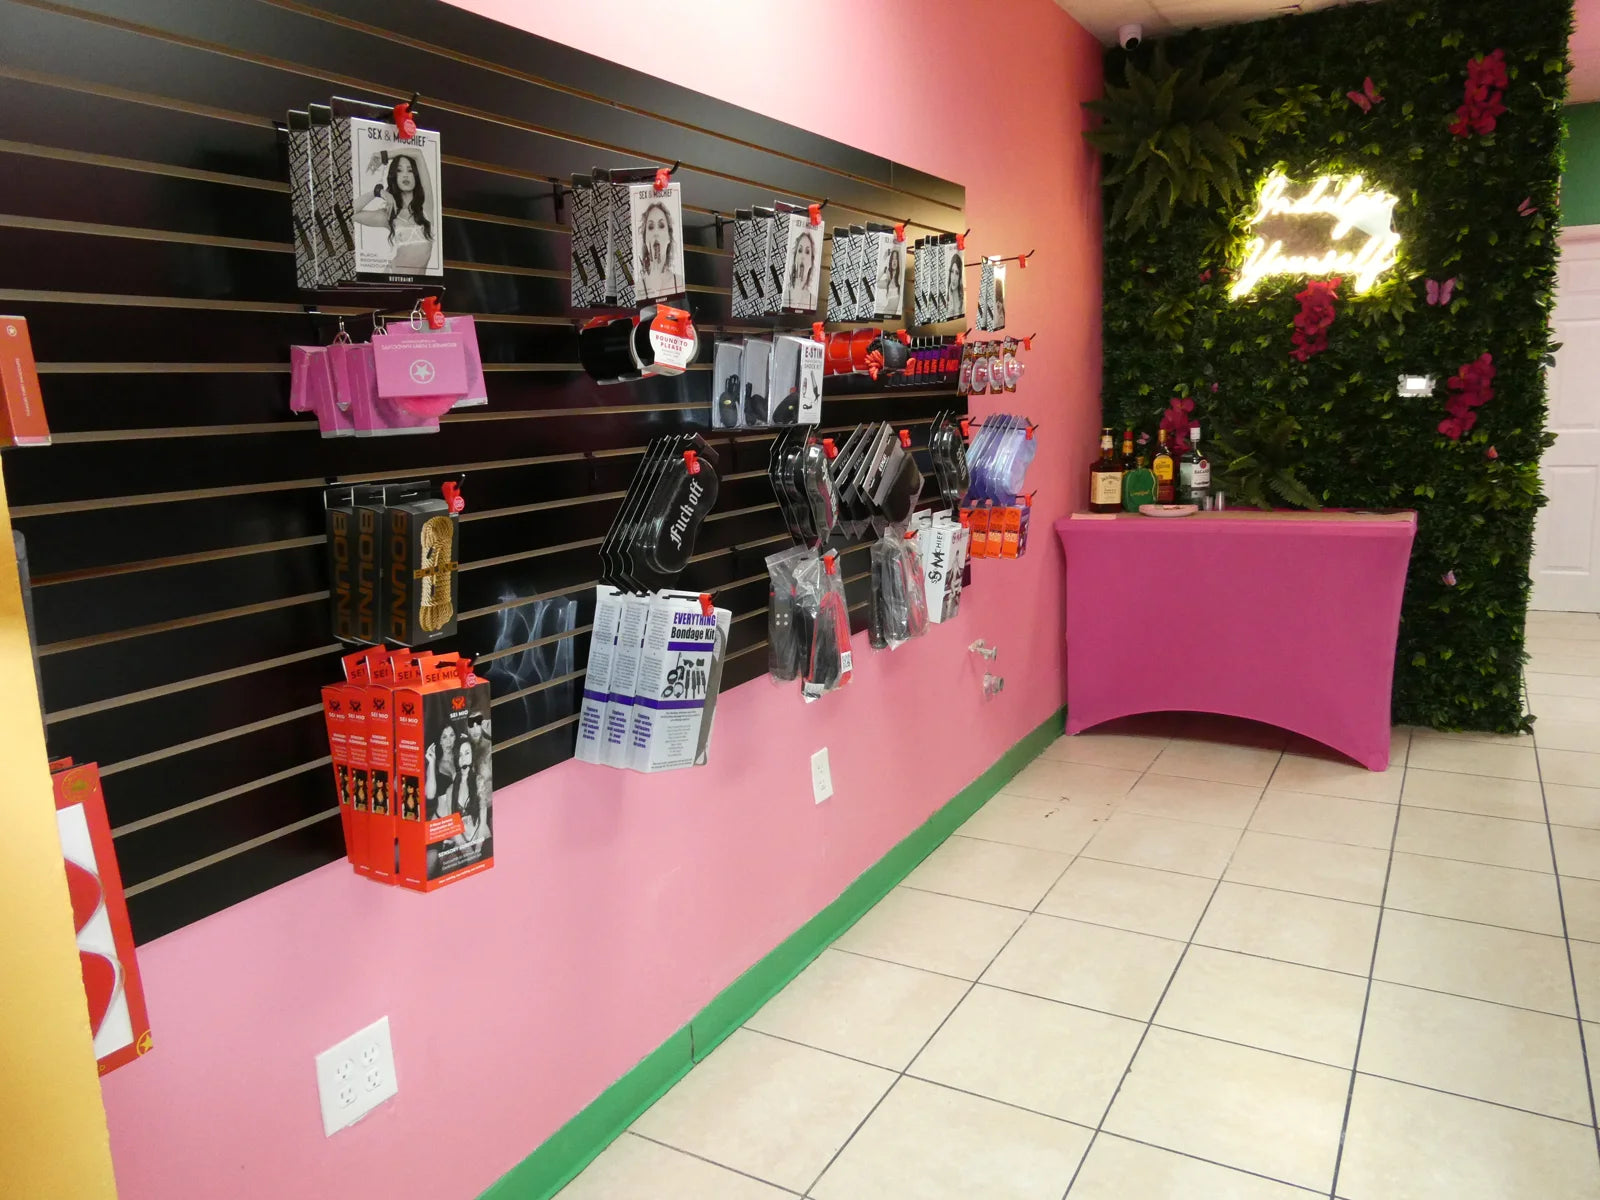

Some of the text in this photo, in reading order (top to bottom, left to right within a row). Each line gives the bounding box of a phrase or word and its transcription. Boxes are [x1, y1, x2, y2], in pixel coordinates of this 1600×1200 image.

[368, 127, 382, 140] SEX
[384, 130, 391, 141] &
[655, 334, 678, 345] BOUND
[660, 341, 682, 351] PLEASE
[669, 478, 704, 551] Fuck off
[673, 612, 716, 626] EVERYTHING
[671, 627, 715, 641] Bondage Kit
[351, 668, 366, 679] SEI
[374, 670, 388, 679] SEI
[398, 671, 413, 680] SEI
[425, 670, 459, 683] SEI MIO
